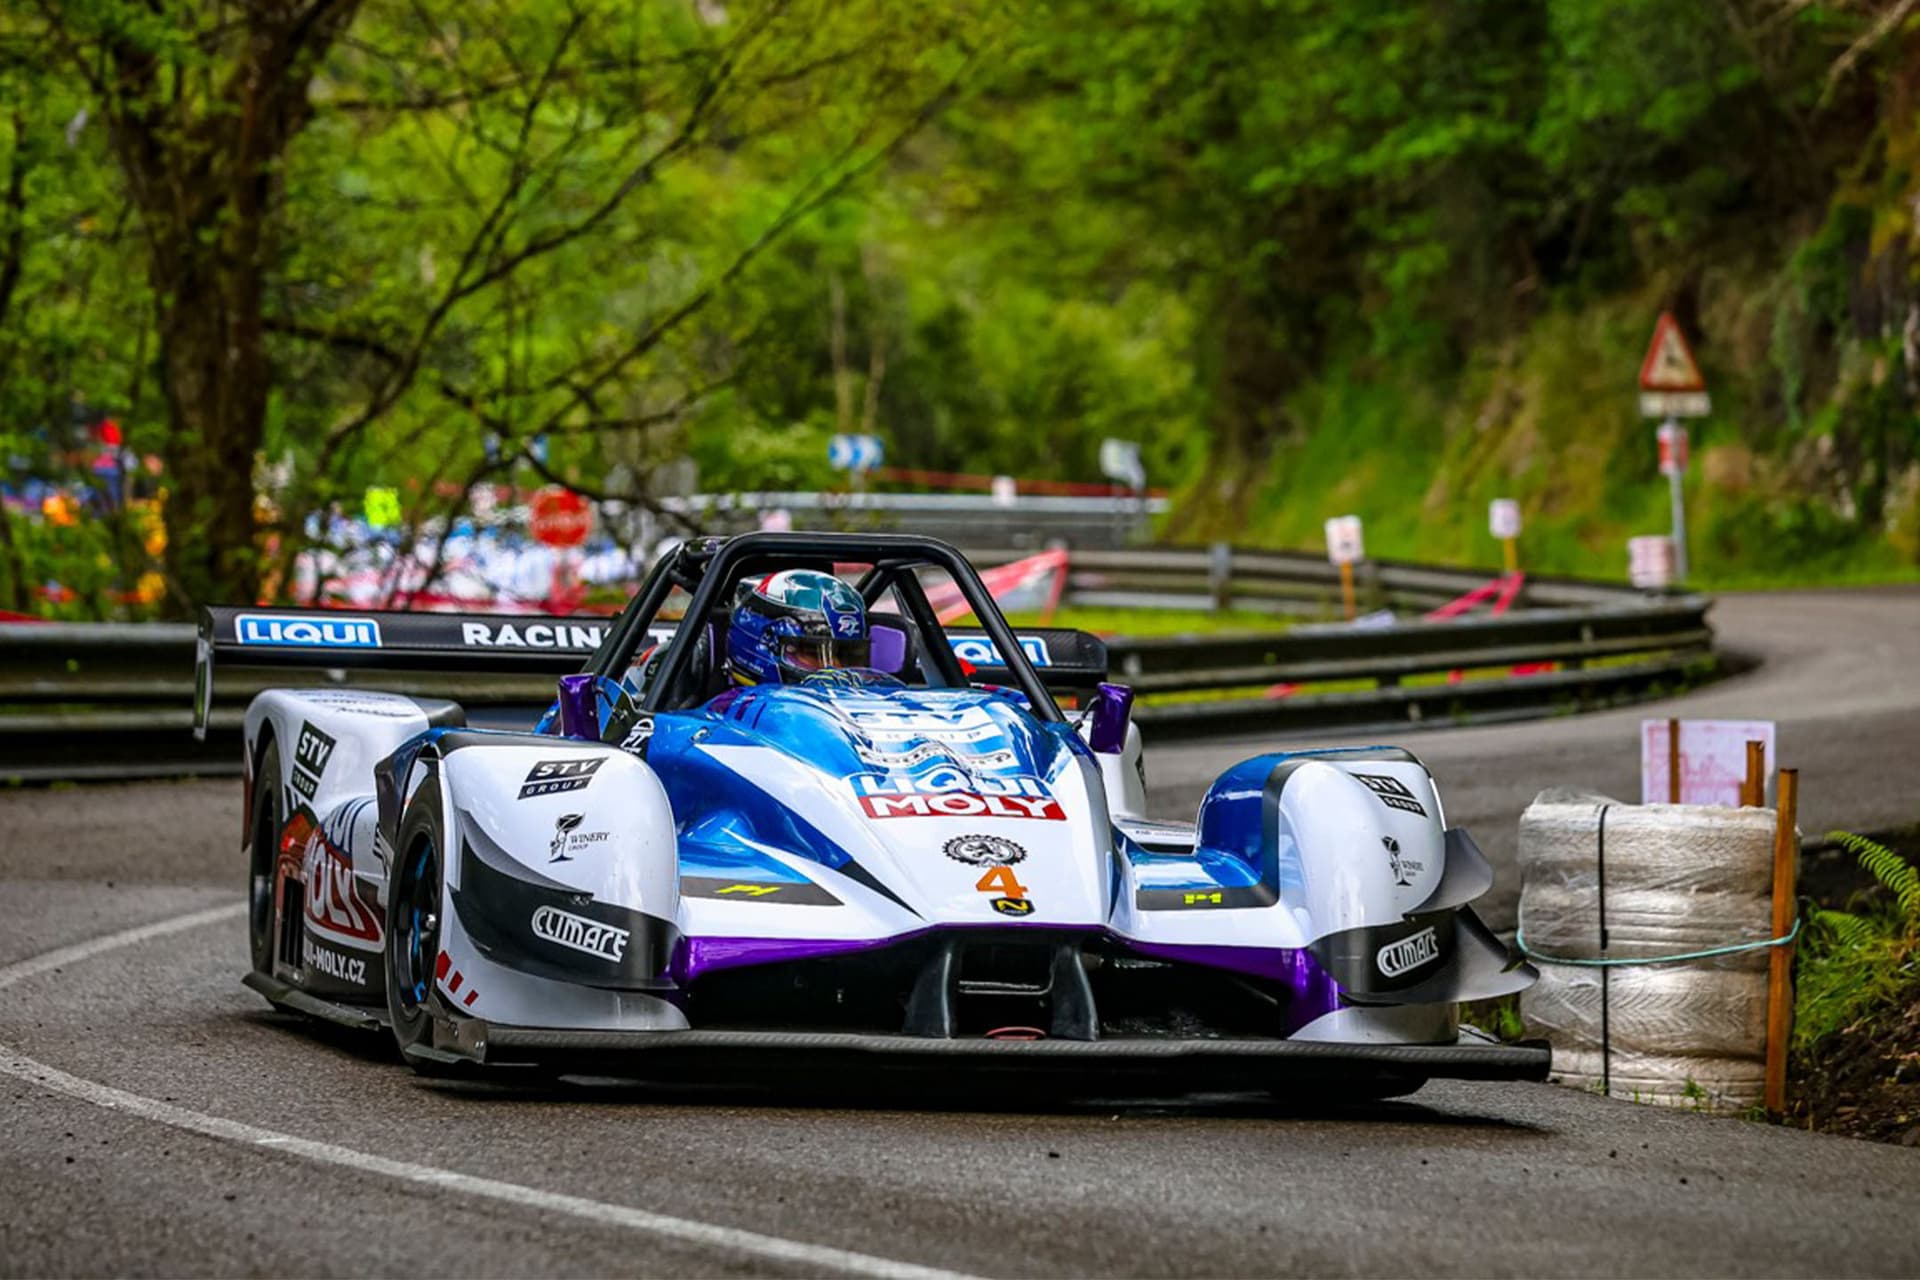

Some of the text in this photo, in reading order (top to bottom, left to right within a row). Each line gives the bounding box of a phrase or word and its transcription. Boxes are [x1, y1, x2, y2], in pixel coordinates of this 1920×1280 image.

[247, 621, 372, 644] LIQUI
[461, 622, 611, 648] RACIN
[536, 761, 599, 777] STV
[526, 780, 583, 796] GROUP
[861, 768, 1048, 796] LIQUI
[868, 794, 1056, 817] MOLY
[569, 831, 611, 845] WINERY
[975, 865, 1028, 898] 4
